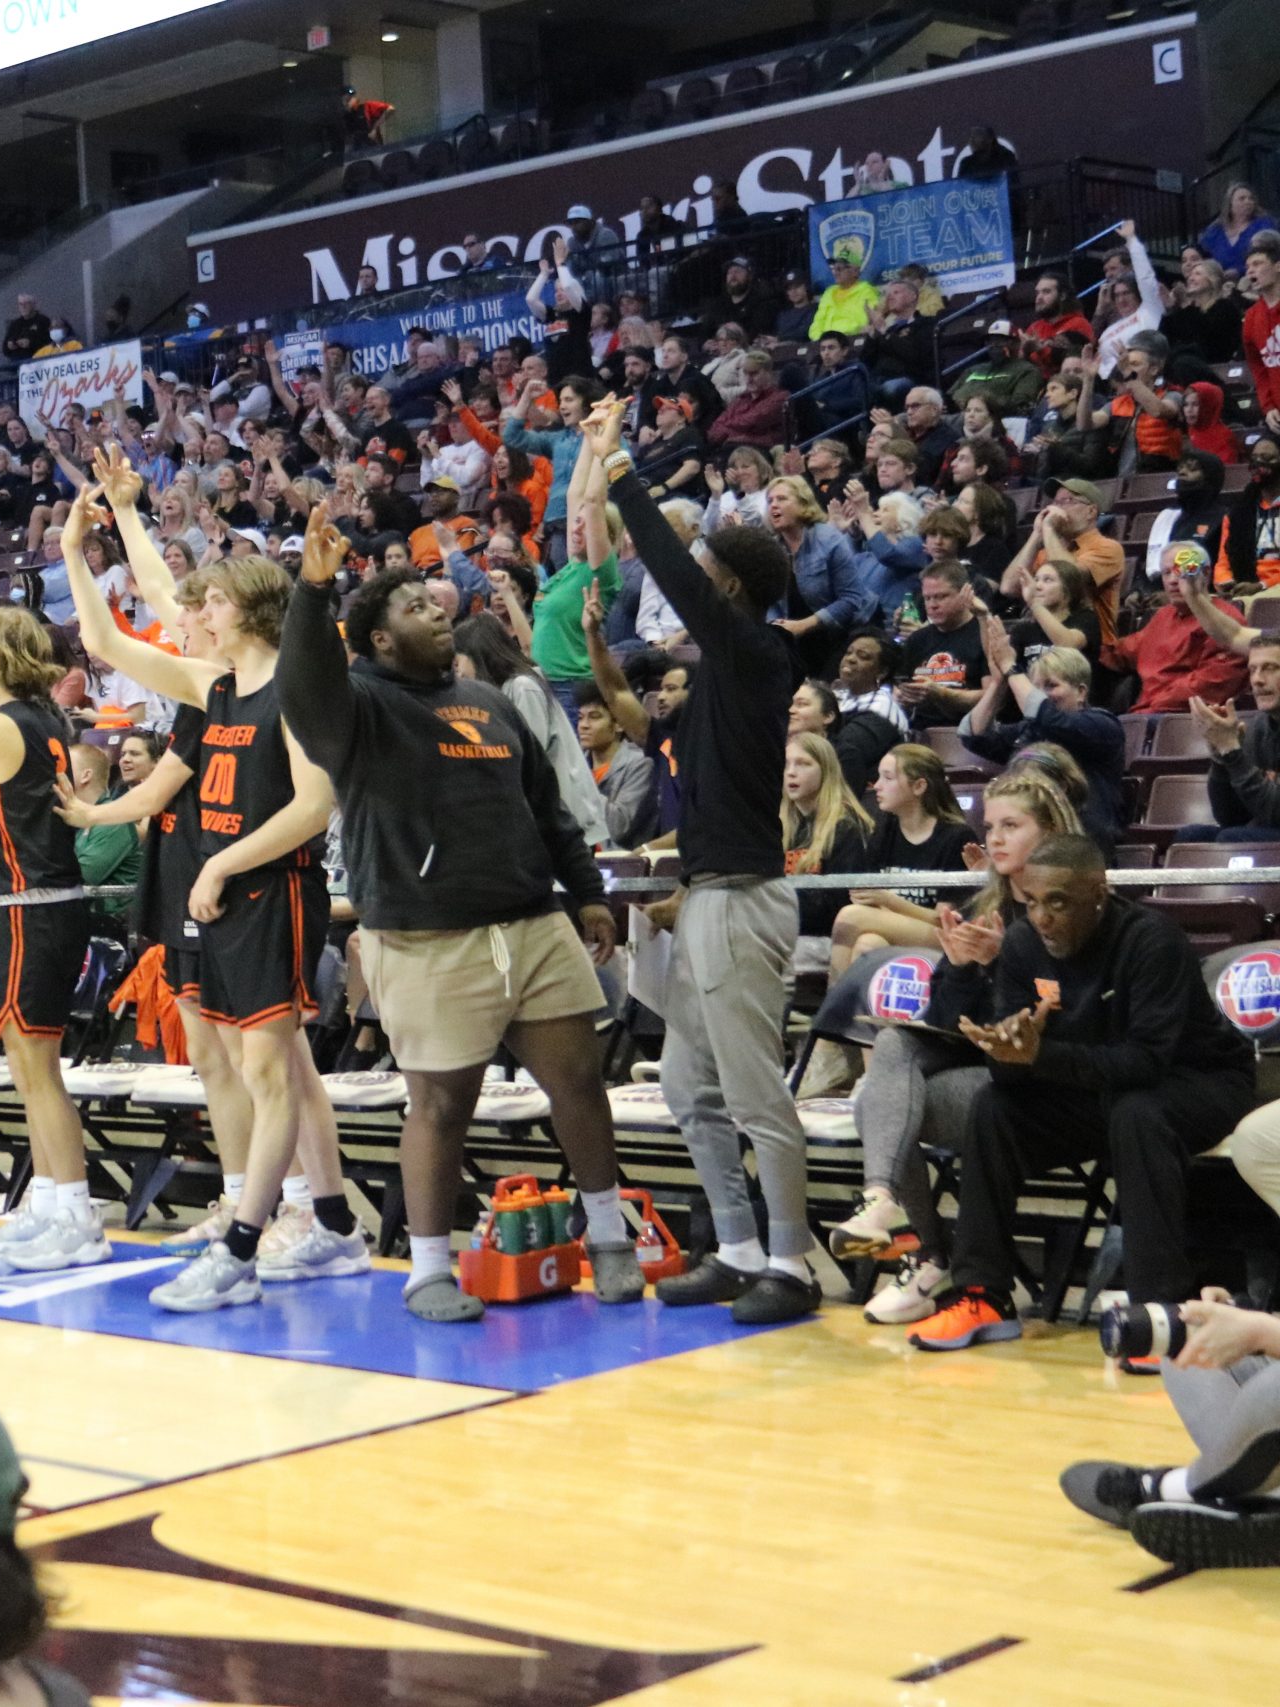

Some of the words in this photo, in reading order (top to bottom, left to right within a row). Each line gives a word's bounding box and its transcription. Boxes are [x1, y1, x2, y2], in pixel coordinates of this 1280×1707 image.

[1159, 47, 1176, 74] C
[878, 203, 935, 228] JOIN
[942, 187, 998, 213] OUR
[879, 209, 1004, 264] TEAM
[199, 256, 212, 277] C
[927, 260, 958, 273] YOUR
[959, 252, 1004, 267] FUTURE
[400, 309, 457, 336] WELCOME
[462, 305, 475, 324] TO
[482, 299, 504, 319] THE
[53, 358, 100, 378] DEALERS
[352, 341, 411, 375] SHSAA
[438, 742, 512, 759] BASKETBALL
[200, 753, 237, 806] 00
[538, 1255, 558, 1288] G
